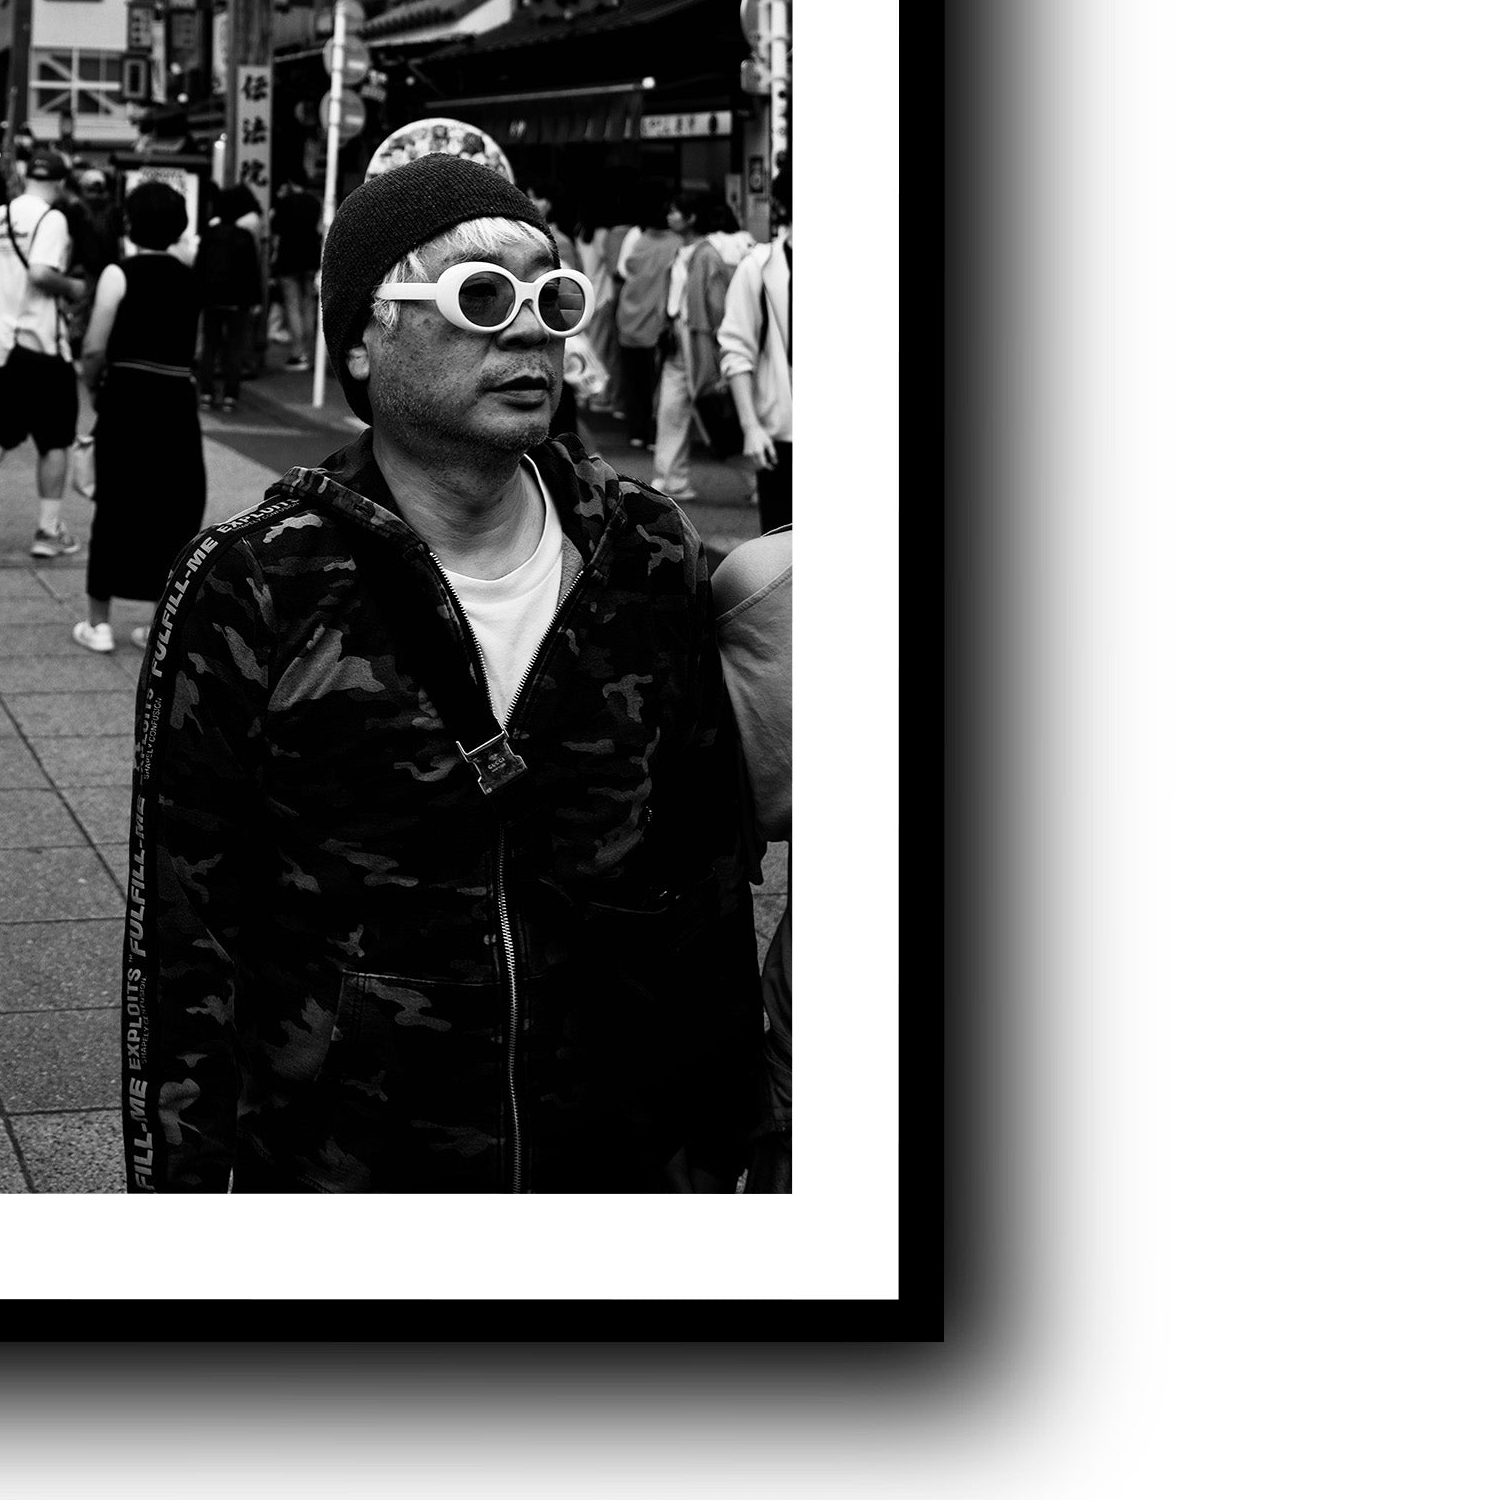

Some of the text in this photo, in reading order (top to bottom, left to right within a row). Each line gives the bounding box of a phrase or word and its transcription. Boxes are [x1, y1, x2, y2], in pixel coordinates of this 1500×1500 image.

[152, 536, 219, 677] FULFILL-ME
[130, 794, 147, 957] FULFILL-ME
[127, 968, 142, 1070] EXPLOITS
